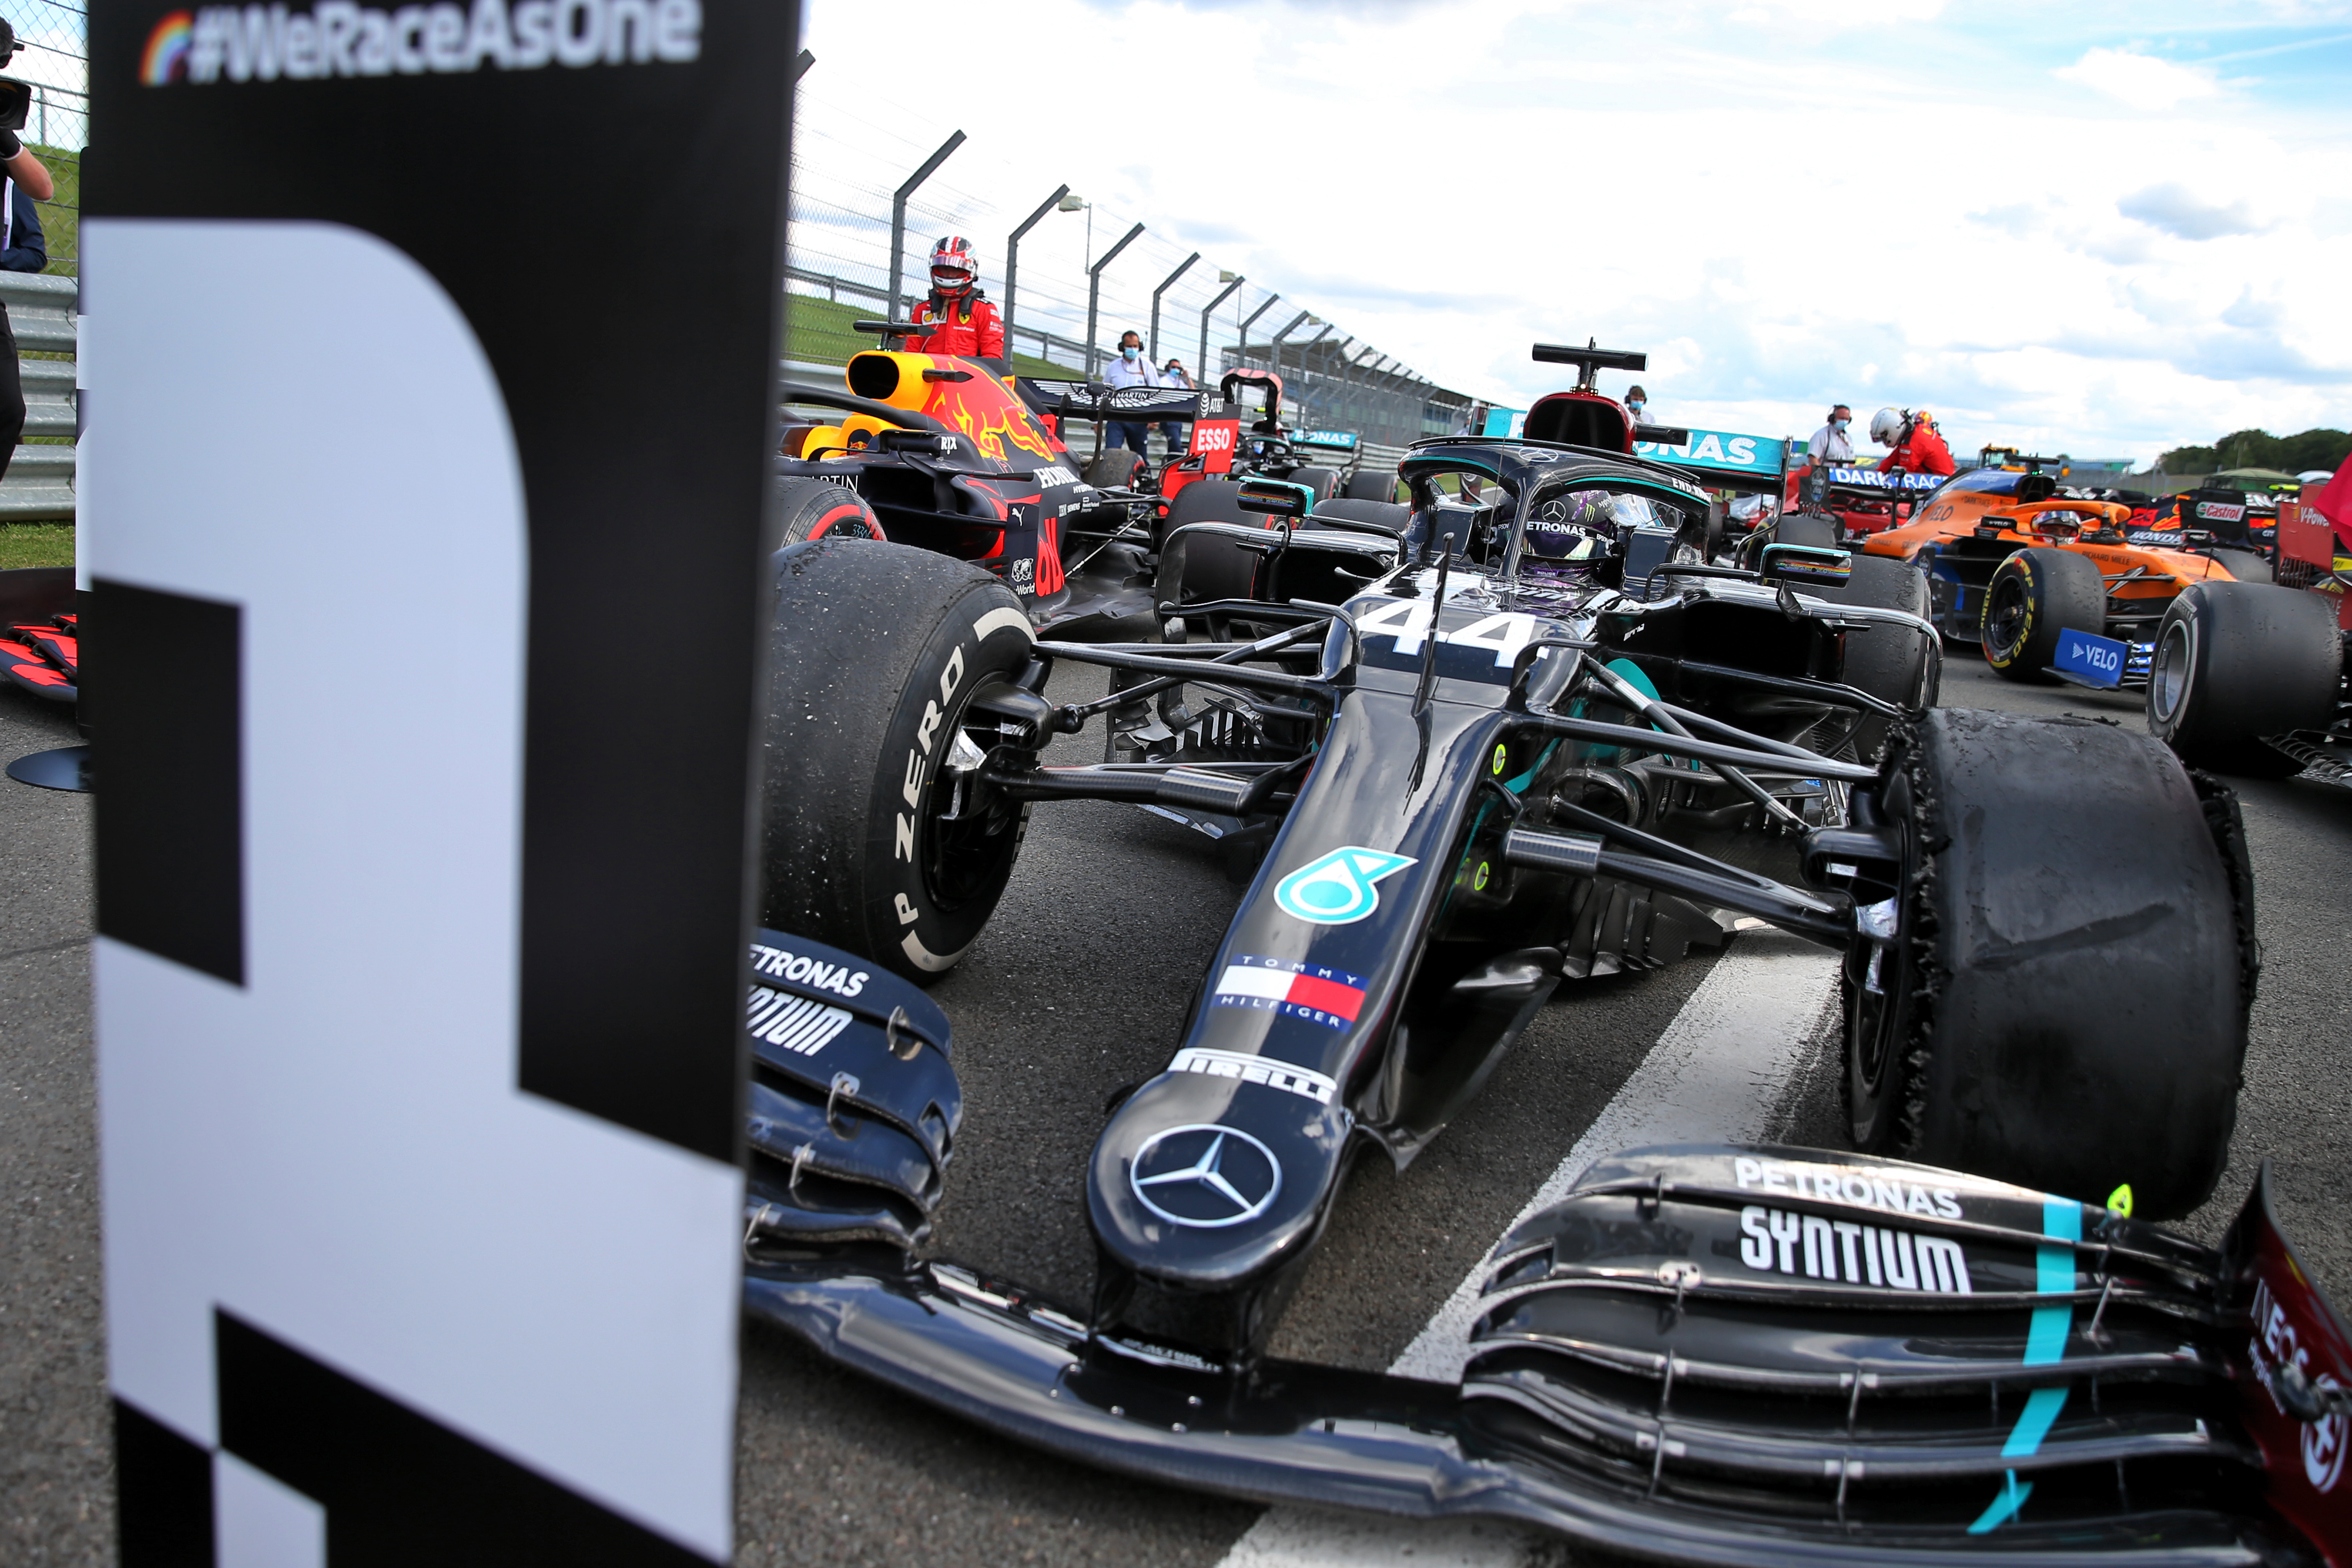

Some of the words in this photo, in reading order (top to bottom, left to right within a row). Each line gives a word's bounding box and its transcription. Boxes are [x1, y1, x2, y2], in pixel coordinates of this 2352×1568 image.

[187, 0, 702, 83] #WeRaceAsOne
[1209, 397, 1225, 413] AT&T
[1196, 427, 1230, 451] ESSO
[2127, 507, 2160, 527] 23
[2206, 504, 2241, 519] Castrol
[1526, 521, 1586, 537] ETRONAS
[2130, 530, 2183, 544] HONDA
[2082, 550, 2109, 562] RICHARD
[2111, 556, 2131, 566] MILLE
[1355, 598, 1537, 668] 44
[2013, 596, 2034, 658] ZERO
[2086, 644, 2118, 671] VELO
[895, 645, 965, 863] ZERO
[894, 892, 919, 925] P
[1243, 956, 1358, 985] TOMMY
[1221, 996, 1340, 1028] HILFIGER
[1167, 1047, 1338, 1106] PIRELLI
[1735, 1156, 1964, 1220] PETRONAS
[1740, 1205, 1973, 1296] SYNTIUM
